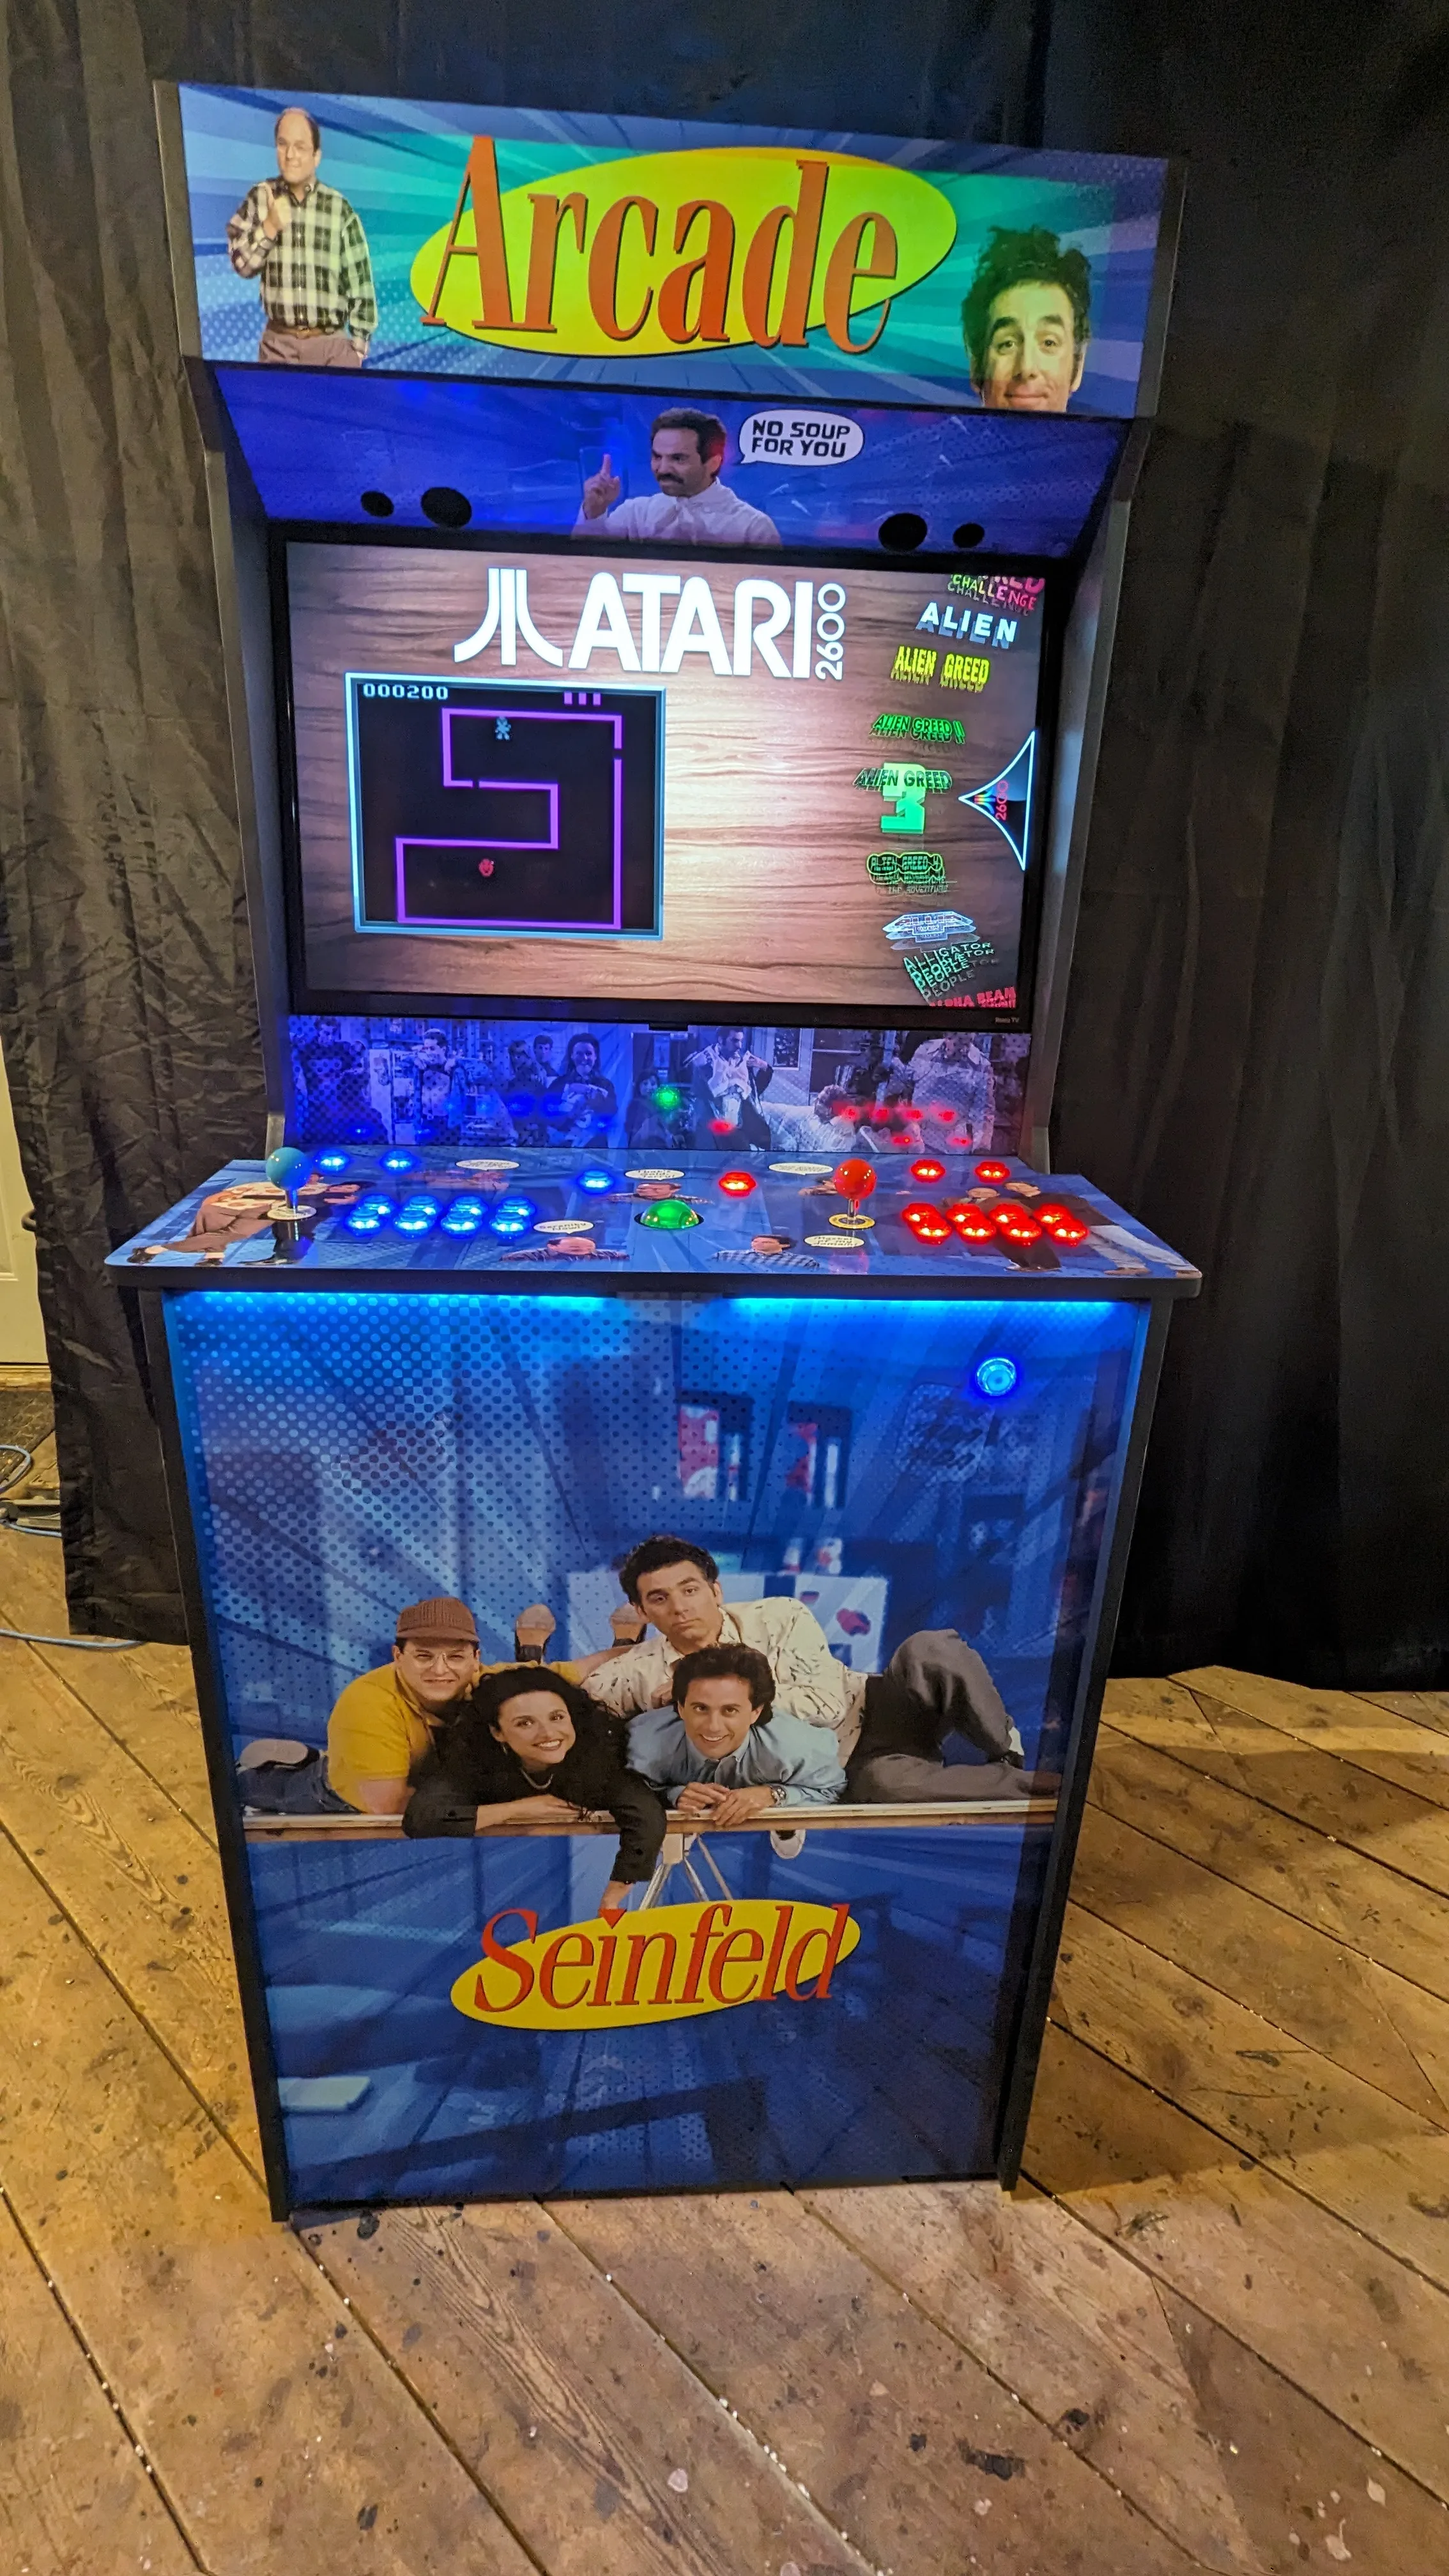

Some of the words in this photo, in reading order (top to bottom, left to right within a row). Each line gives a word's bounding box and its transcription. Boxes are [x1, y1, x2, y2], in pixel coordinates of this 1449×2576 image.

[420, 135, 898, 353] Arcade
[751, 437, 794, 456] FOR
[801, 440, 847, 458] YOU
[753, 419, 783, 436] NO
[790, 422, 850, 439] SOUP
[952, 574, 1037, 611] CHALLENGE
[568, 572, 813, 679] ATARI
[815, 582, 847, 681] 2600
[920, 602, 1017, 642] ALIEN
[894, 646, 937, 677] ALIEN
[944, 653, 990, 685] GREED
[363, 683, 448, 700] 000200
[873, 714, 911, 731] ALIEN
[912, 717, 953, 735] GREED
[854, 768, 899, 786] ALIEN
[903, 769, 953, 790] GREED
[995, 780, 1009, 821] 2600
[903, 942, 992, 970] ALLIGATOR
[473, 1903, 850, 2012] Seinfeld
